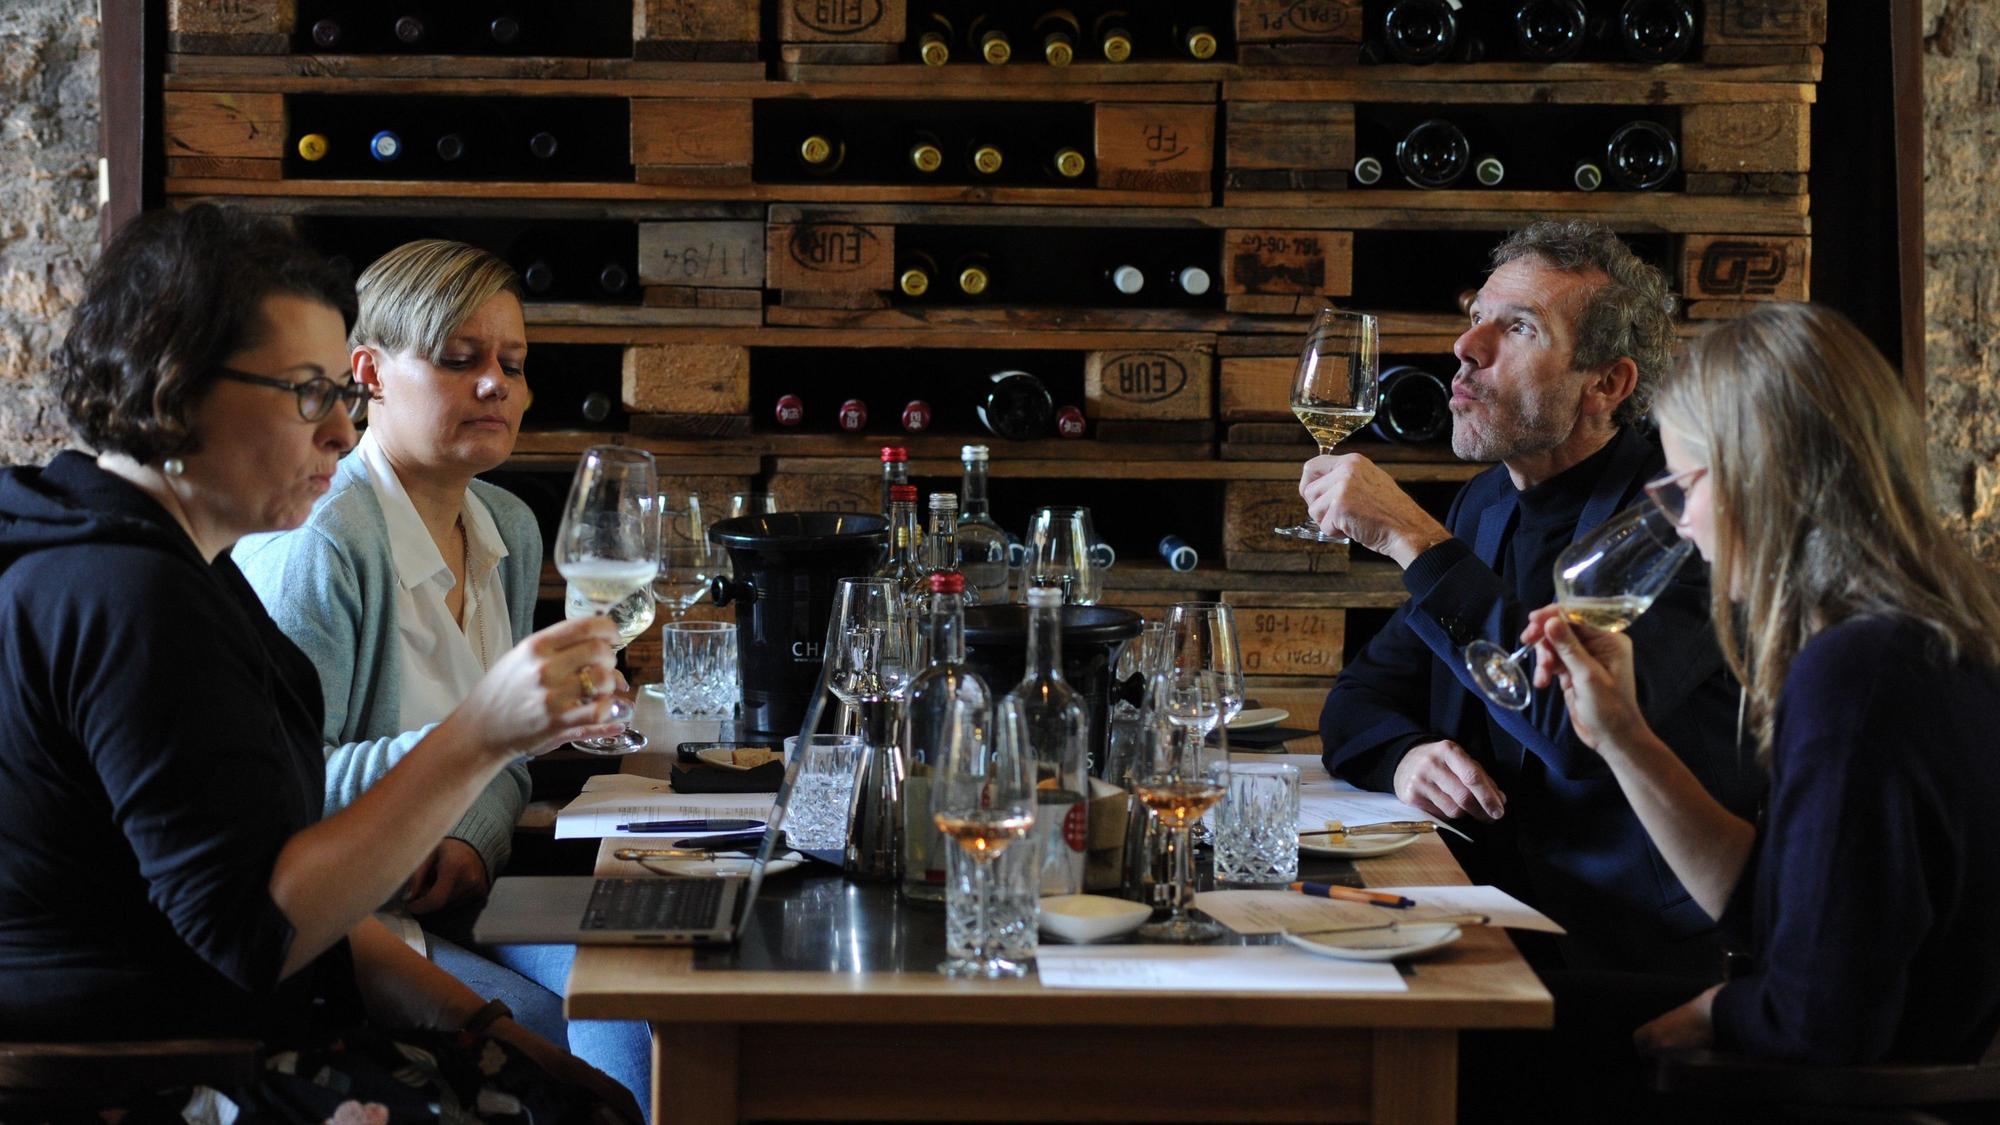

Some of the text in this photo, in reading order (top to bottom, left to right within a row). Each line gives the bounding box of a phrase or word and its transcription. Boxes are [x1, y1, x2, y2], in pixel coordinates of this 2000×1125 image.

[663, 242, 748, 280] 11/94
[811, 232, 863, 264] EUR
[1119, 361, 1168, 394] EUR
